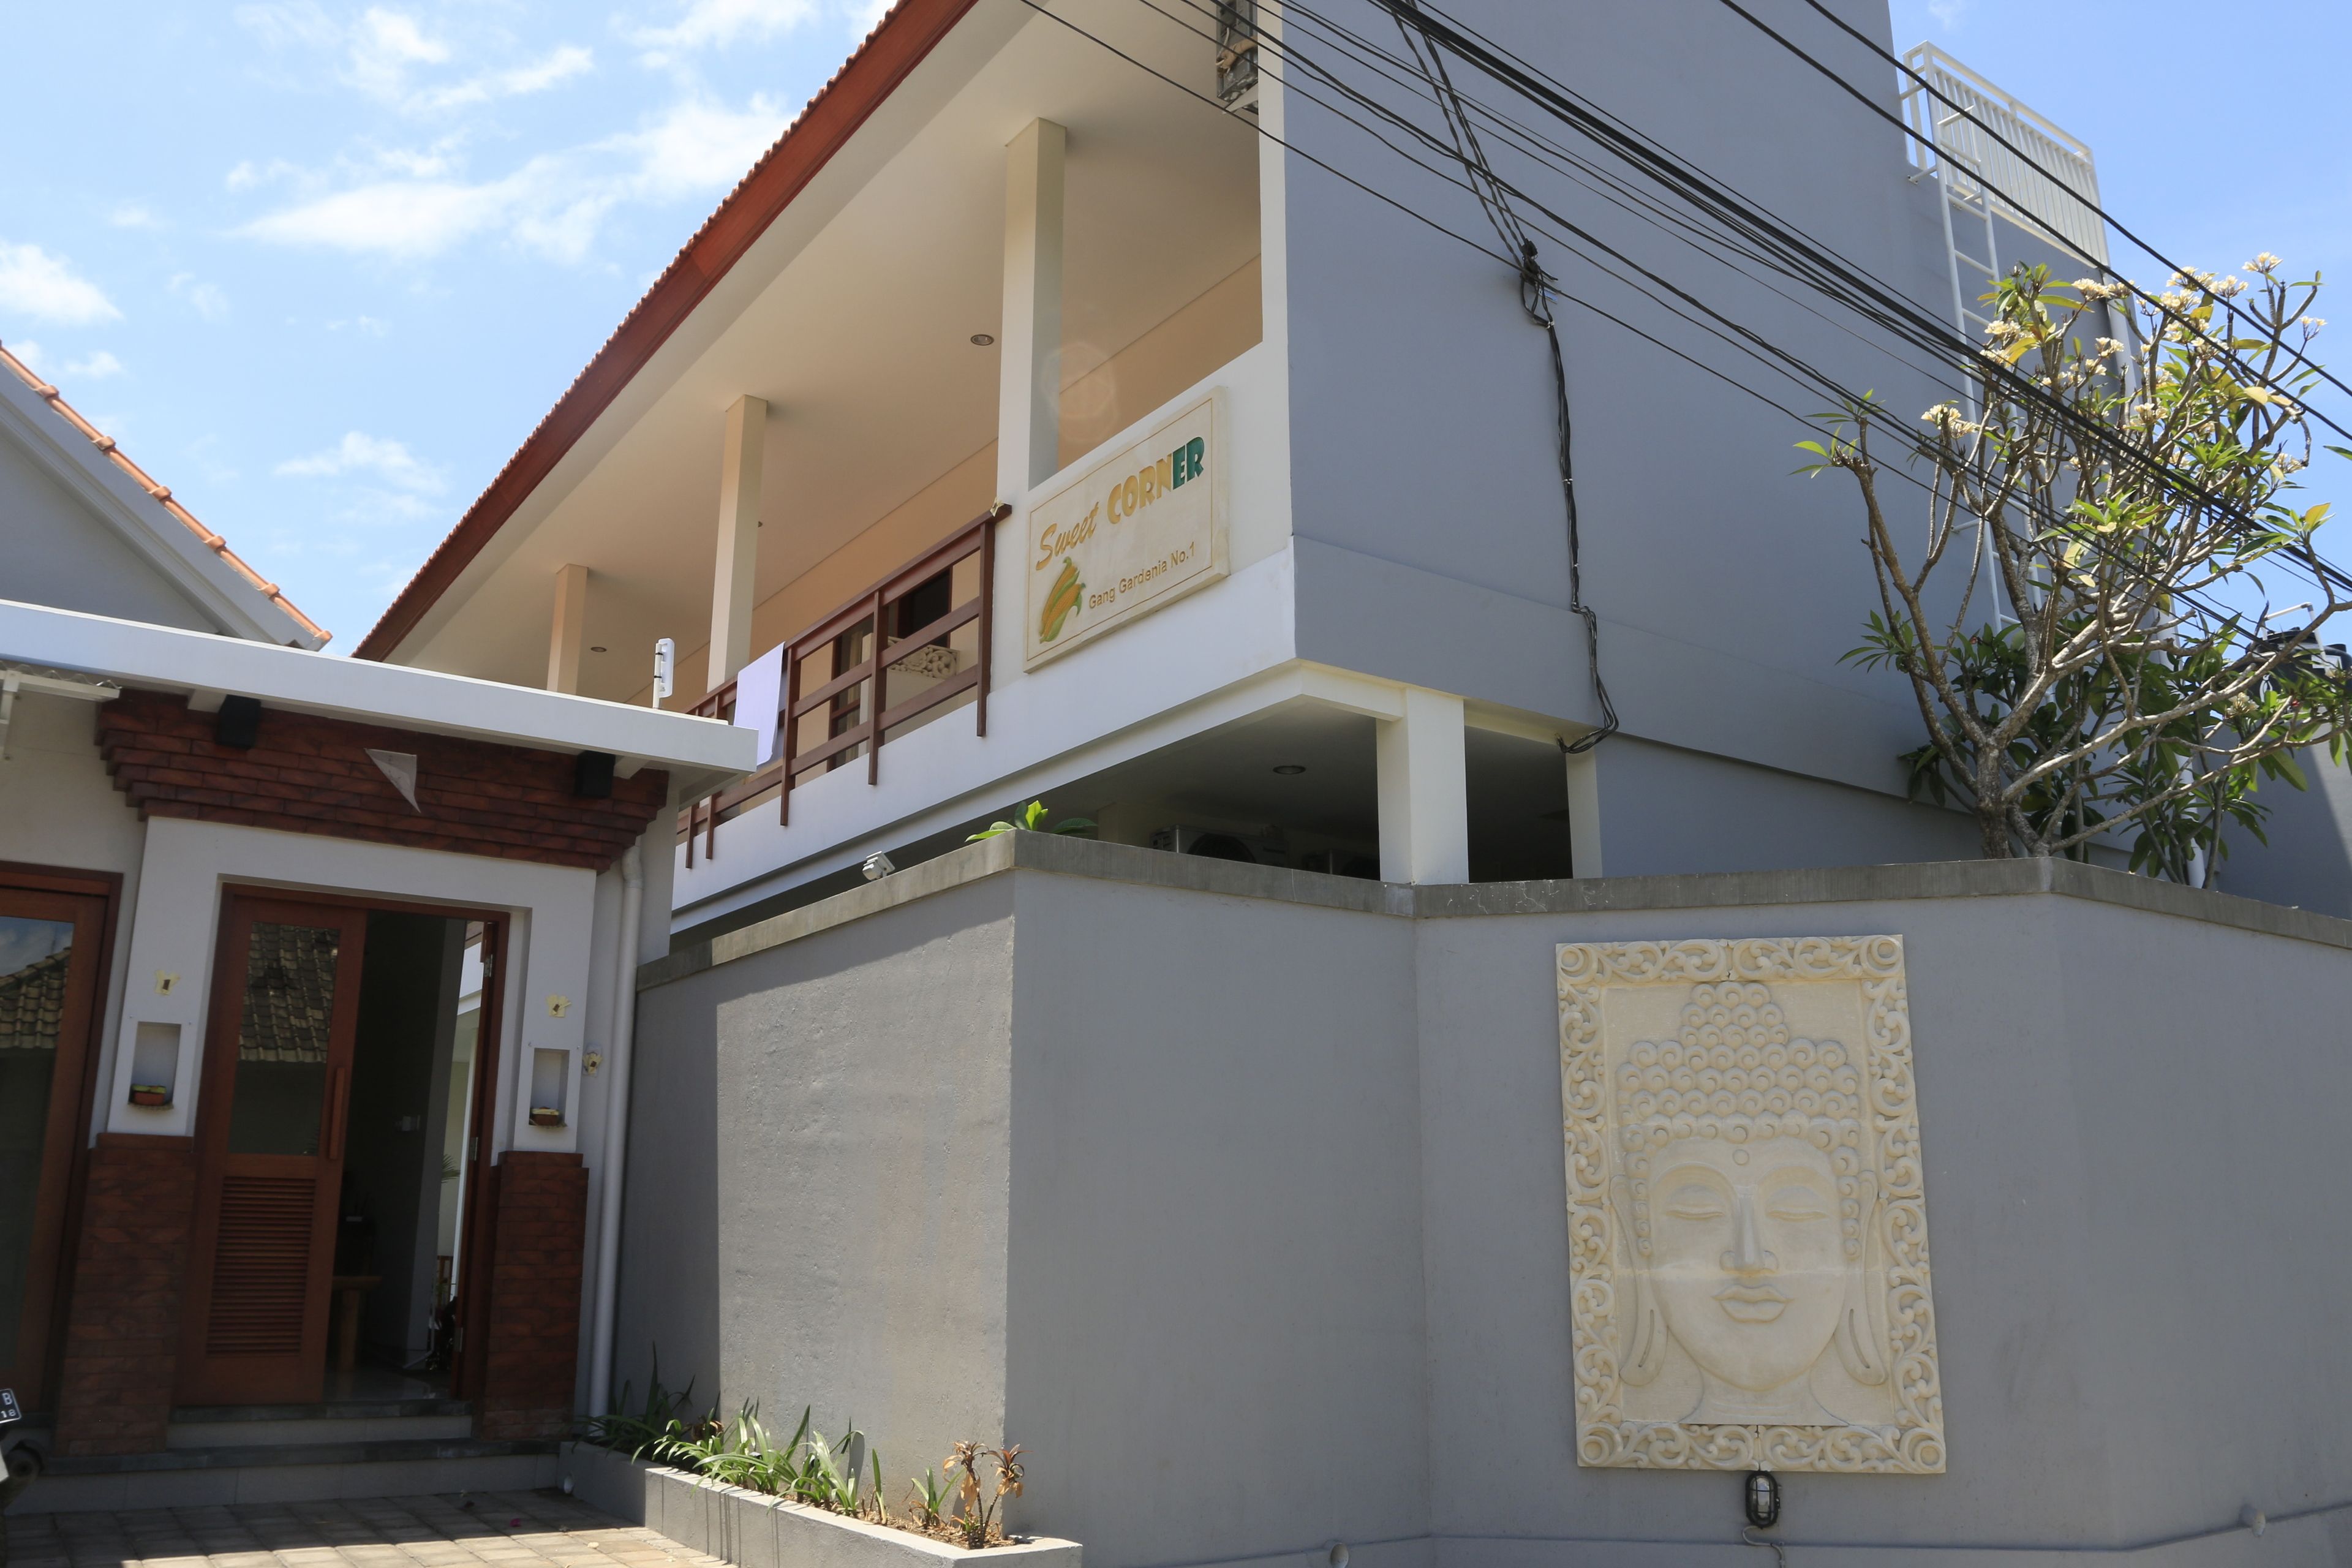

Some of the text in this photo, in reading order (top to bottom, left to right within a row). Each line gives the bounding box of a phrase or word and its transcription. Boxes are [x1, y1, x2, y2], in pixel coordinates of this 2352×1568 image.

[1036, 436, 1205, 570] Sweet CORNER
[1089, 541, 1195, 609] Gang Gardenia No.1
